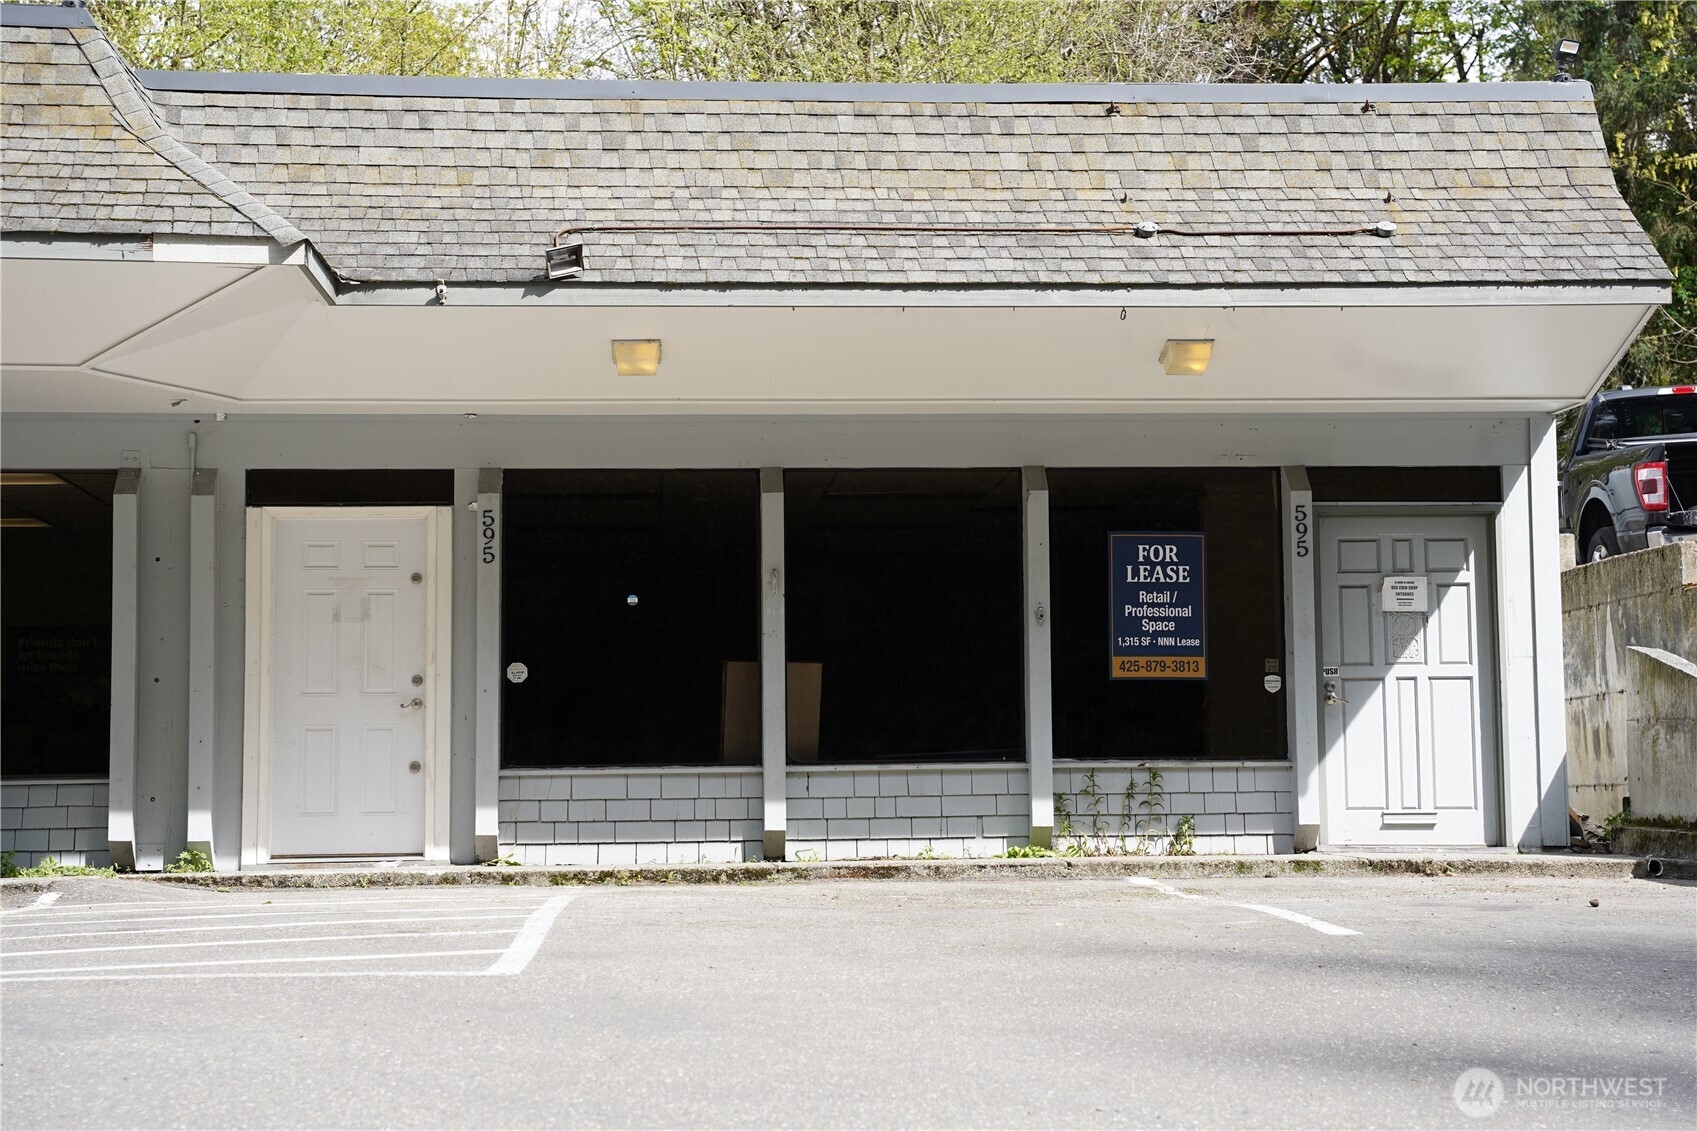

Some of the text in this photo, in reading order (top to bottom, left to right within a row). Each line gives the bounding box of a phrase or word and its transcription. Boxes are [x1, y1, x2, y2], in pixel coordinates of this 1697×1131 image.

[482, 509, 496, 564] 595
[1294, 504, 1309, 557] 595
[1137, 544, 1179, 562] FOR
[1126, 565, 1190, 583] LEASE
[1139, 590, 1178, 603] Retail /
[1124, 604, 1192, 617] Professional
[1141, 618, 1176, 633] Space
[1117, 636, 1140, 647] 1,315
[1141, 637, 1152, 646] SF
[1157, 636, 1175, 646] NNN
[1176, 637, 1200, 646] Lease
[1118, 660, 1200, 673] 425-879-3813
